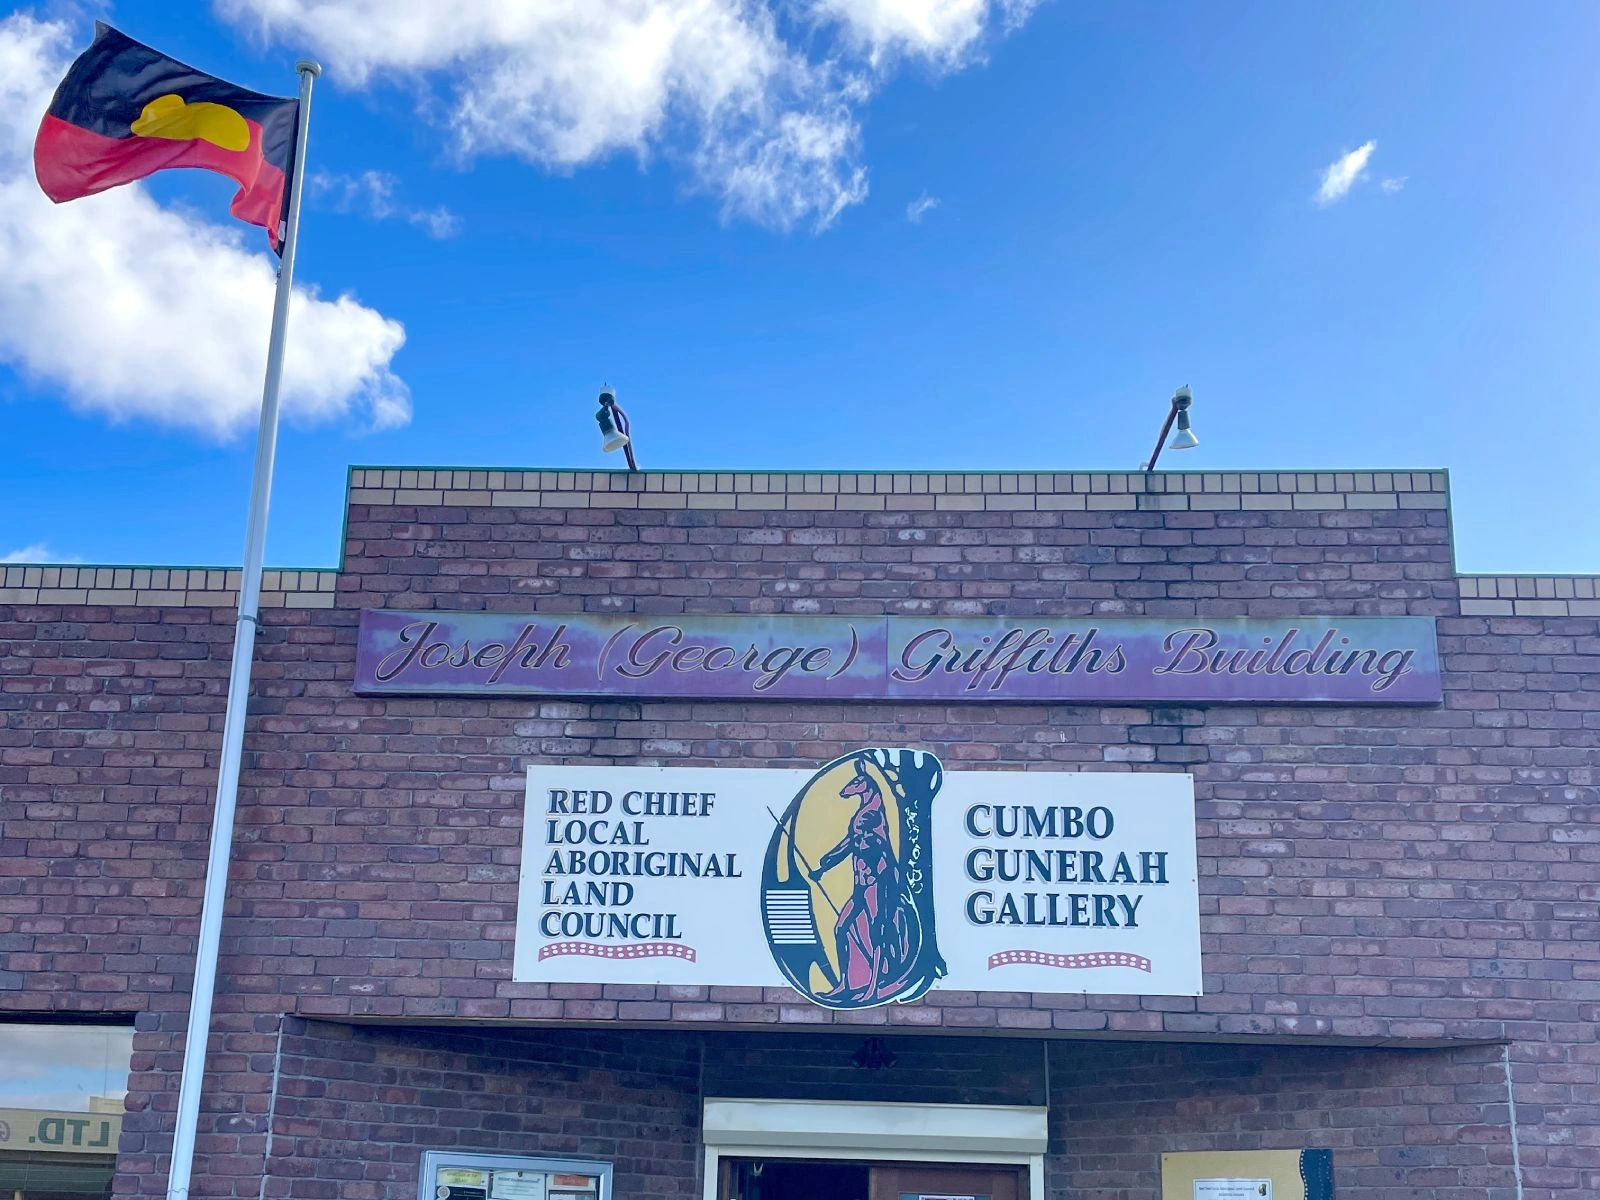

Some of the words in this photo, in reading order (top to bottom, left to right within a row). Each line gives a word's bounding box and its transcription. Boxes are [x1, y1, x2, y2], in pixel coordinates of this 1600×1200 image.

[375, 621, 571, 684] Joseph
[599, 622, 861, 692] (George)
[890, 627, 1128, 692] Griffiths
[1152, 627, 1415, 692] Building
[548, 789, 613, 815] RED
[622, 791, 716, 816] CHIEF
[546, 819, 650, 845] LOCAL
[965, 803, 1115, 839] CUMBO
[544, 849, 743, 878] ABORIGINAL
[965, 847, 1169, 885] GUNERAH
[542, 880, 634, 906] LAND
[965, 890, 1143, 928] GALLERY
[540, 911, 683, 939] COUNCIL
